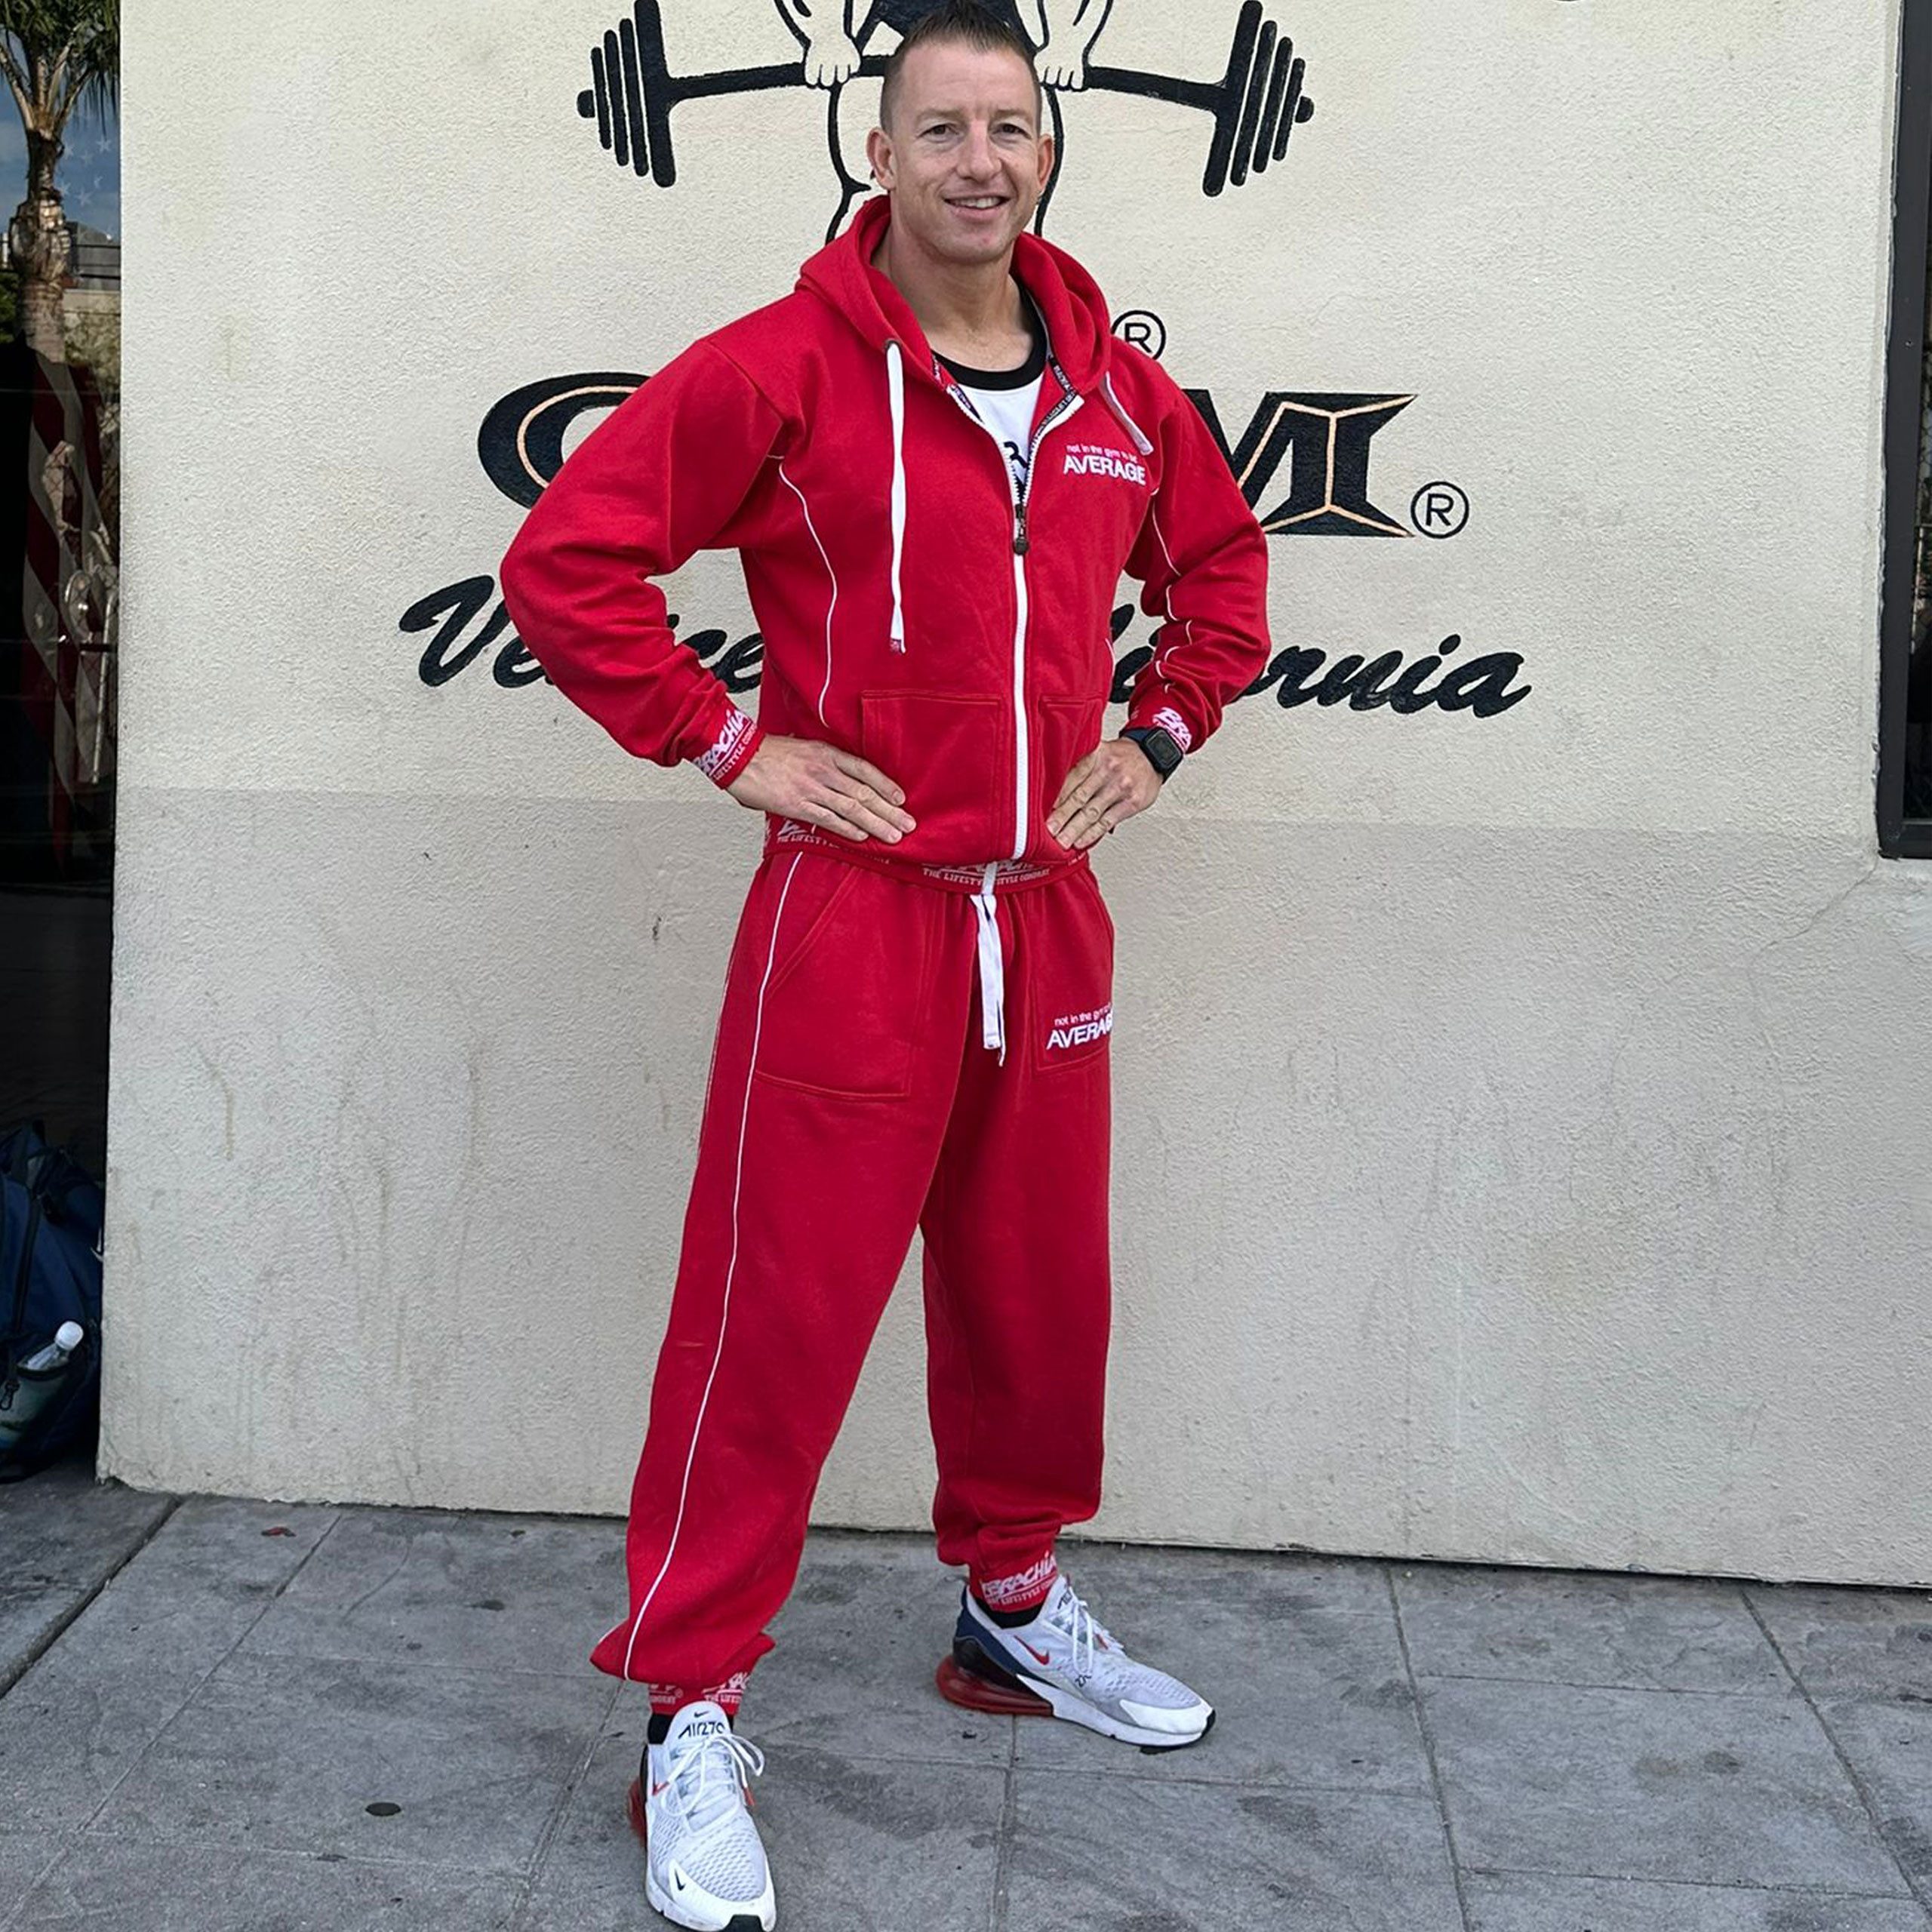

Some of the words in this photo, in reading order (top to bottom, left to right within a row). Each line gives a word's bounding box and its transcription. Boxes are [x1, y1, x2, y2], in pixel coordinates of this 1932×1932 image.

[1063, 454, 1146, 486] AVERAGE
[923, 868, 941, 879] THE
[943, 872, 982, 887] LIFESTY
